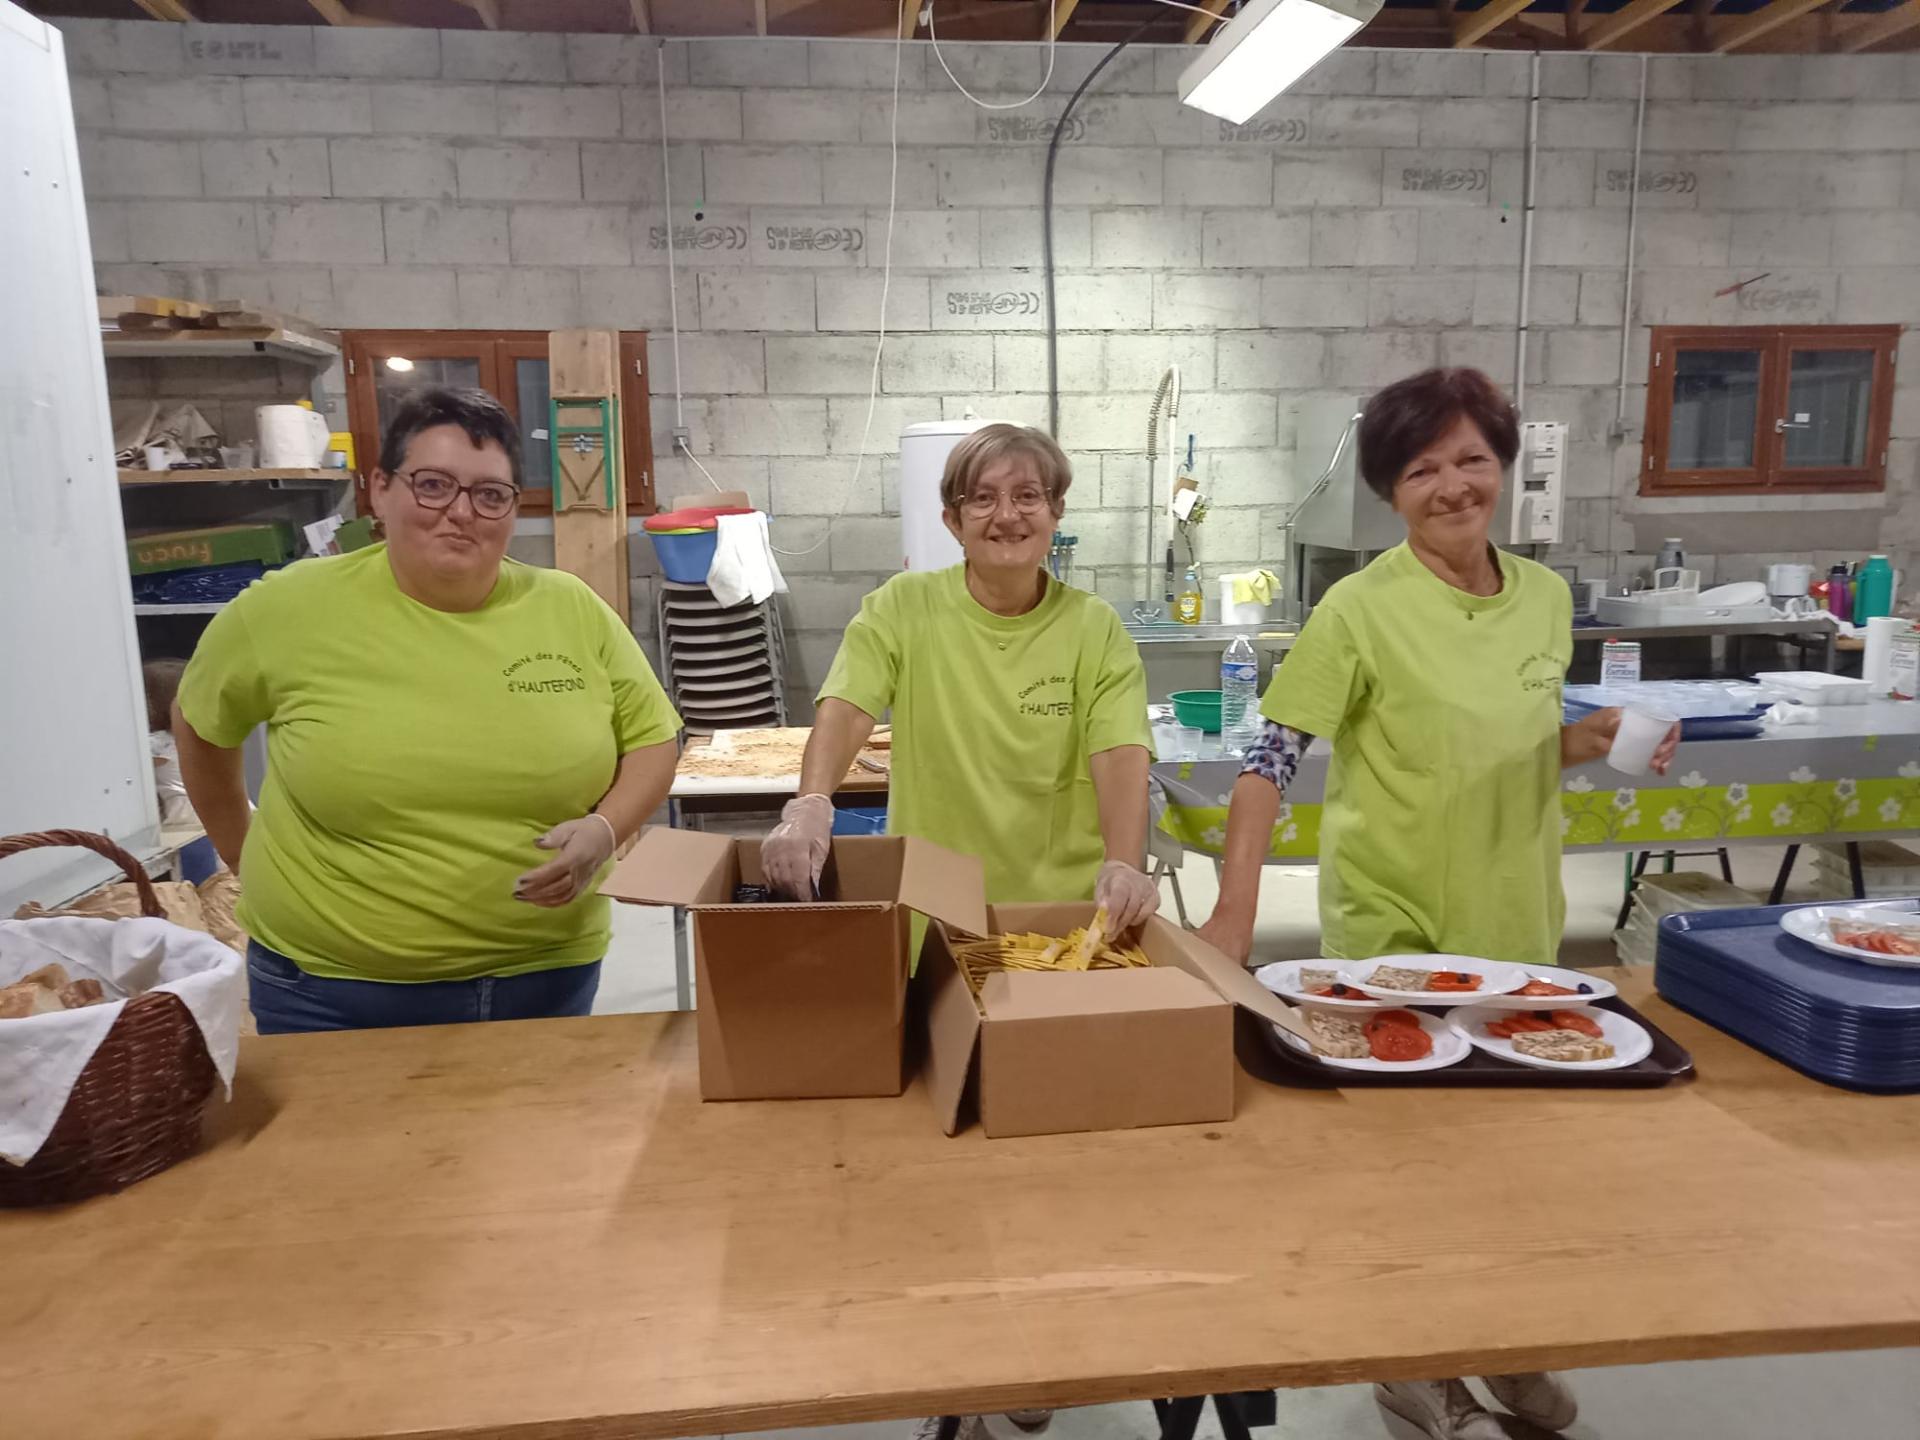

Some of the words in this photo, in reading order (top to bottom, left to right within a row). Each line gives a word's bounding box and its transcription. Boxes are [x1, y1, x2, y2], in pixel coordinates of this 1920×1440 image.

[502, 655, 532, 677] Comité
[535, 652, 553, 661] des
[507, 677, 586, 693] d'HAUTEFOND
[1049, 675, 1066, 684] des
